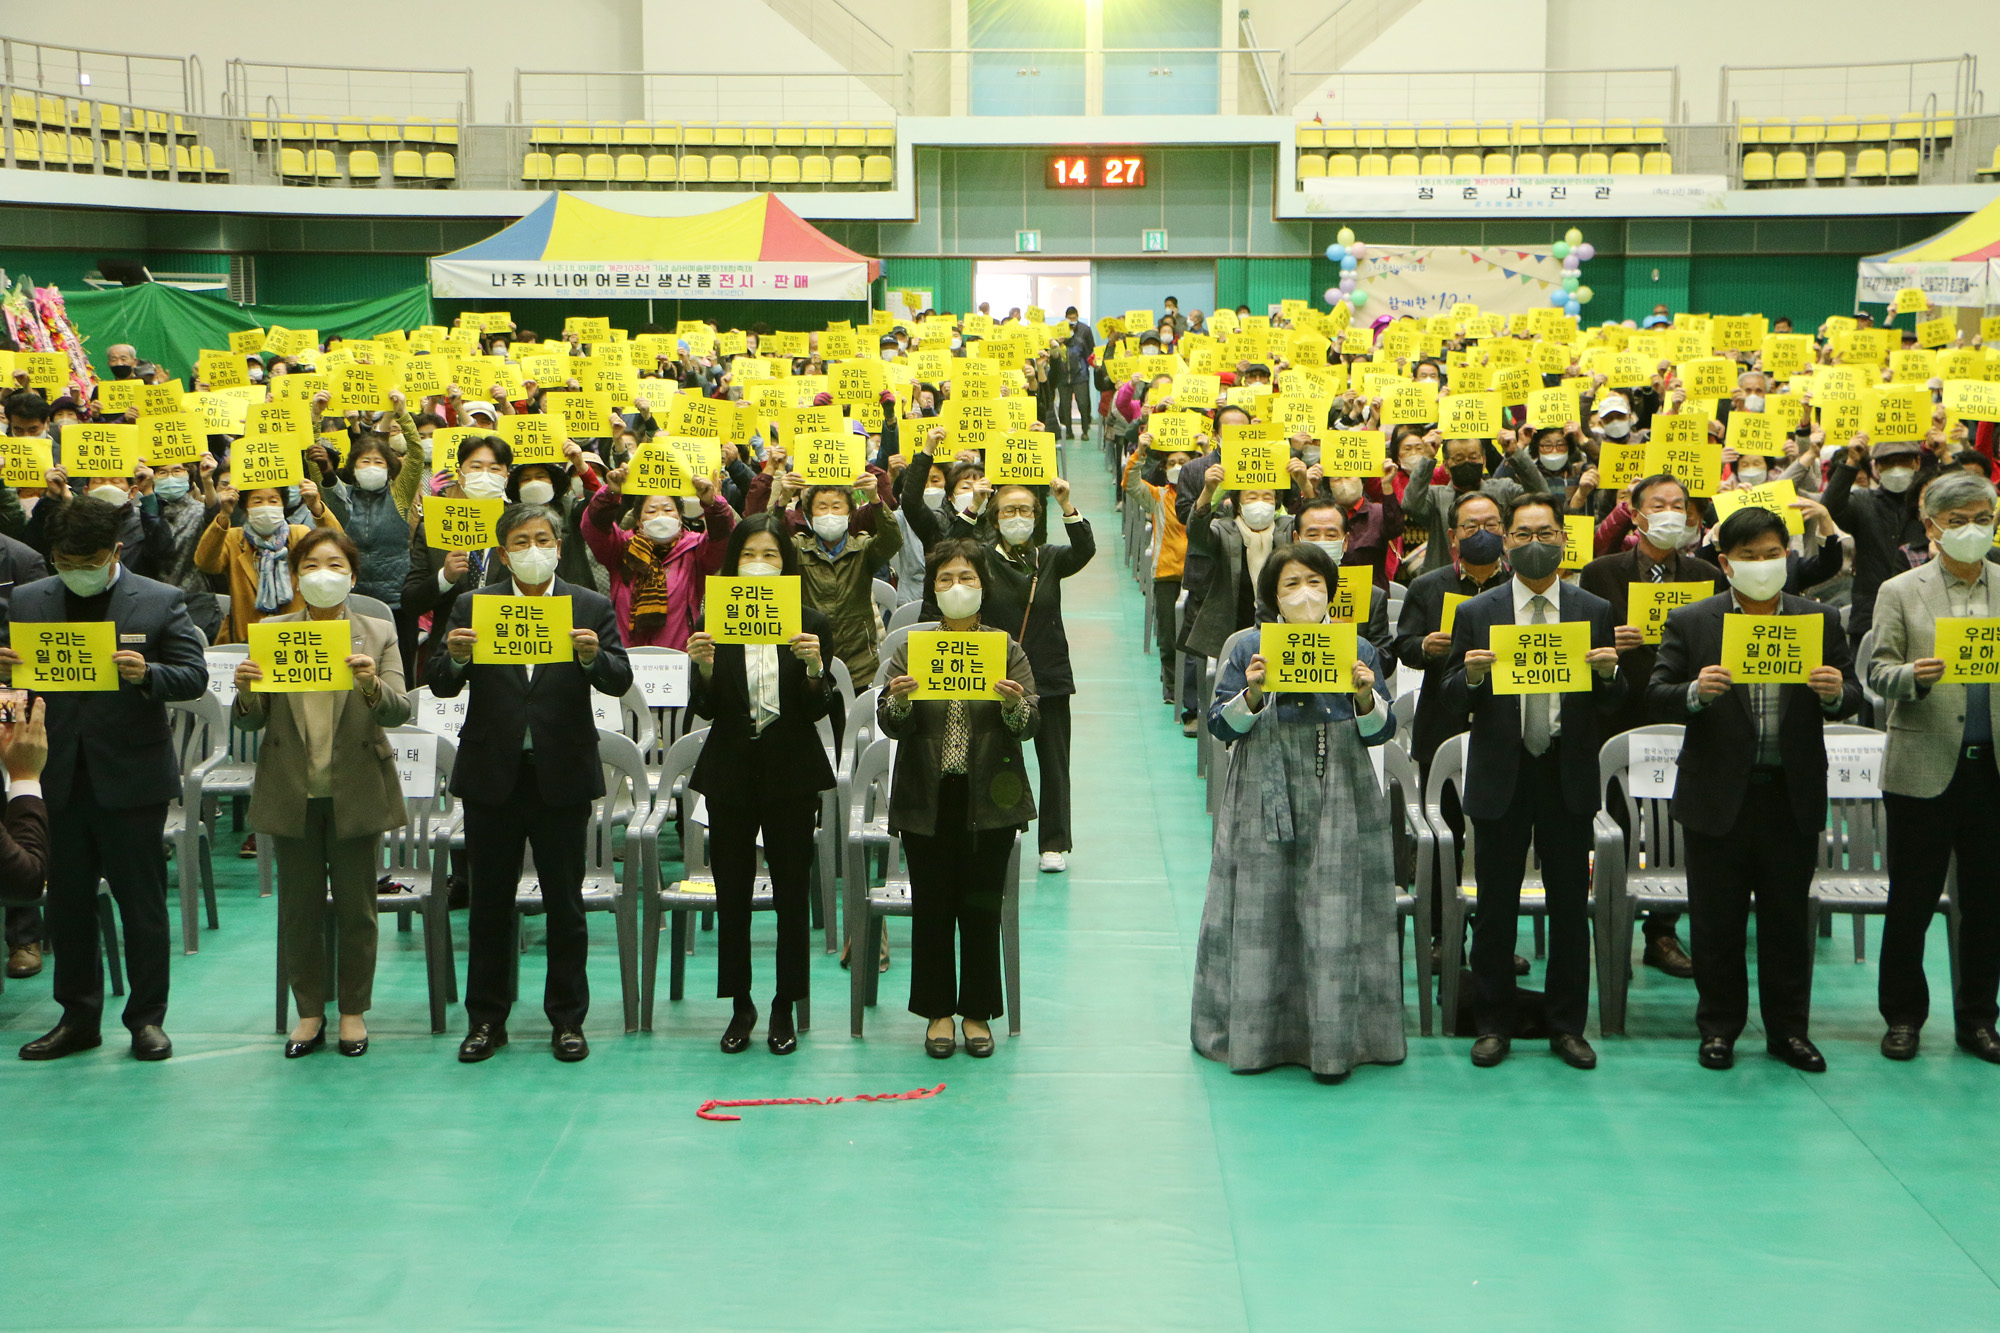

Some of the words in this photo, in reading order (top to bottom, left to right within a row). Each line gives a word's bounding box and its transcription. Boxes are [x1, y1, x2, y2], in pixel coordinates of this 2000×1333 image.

[1054, 160, 1087, 184] 14
[1105, 159, 1141, 183] 27
[657, 274, 711, 288] 생산품
[406, 361, 432, 371] 우리는
[1616, 357, 1637, 365] 우리는
[346, 370, 374, 381] 우리는
[1614, 374, 1644, 383] 노인이다
[404, 381, 440, 393] 노인이다
[1397, 388, 1422, 397] 우리는
[1964, 385, 1992, 394] 우리는
[342, 394, 380, 405] 노인이다
[1542, 392, 1567, 403] 우리는
[688, 402, 716, 415] 우리는
[1288, 403, 1313, 413] 우리는
[1456, 399, 1483, 409] 우리는
[1880, 399, 1912, 410] 우리는
[1956, 404, 1998, 416] 노인이다
[1393, 409, 1427, 419] 노인이다
[1538, 414, 1564, 423] 노인이다
[154, 421, 187, 433] 우리는
[517, 421, 547, 432] 우리는
[1163, 418, 1186, 426] 우리는
[1450, 423, 1489, 433] 노인이다
[1744, 418, 1770, 429] 우리는
[680, 425, 718, 437] 노인이다
[1284, 424, 1316, 434] 노인이다
[1875, 424, 1918, 436] 노인이다
[82, 431, 116, 443] 우리는
[1158, 438, 1190, 447] 노인이다
[1340, 437, 1368, 447] 우리는
[246, 442, 279, 455] 우리는
[813, 440, 845, 451] 우리는
[1006, 439, 1038, 450] 우리는
[1737, 440, 1773, 451] 노인이다
[153, 446, 196, 460] 노인이다
[513, 446, 555, 458] 노인이다
[644, 450, 675, 462] 우리는
[1241, 448, 1271, 458] 우리는
[77, 459, 124, 471] 노인이다
[1334, 461, 1372, 471] 노인이다
[243, 468, 289, 483] 노인이다
[807, 467, 851, 478] 노인이다
[1000, 467, 1044, 478] 노인이다
[1236, 473, 1277, 484] 노인이다
[638, 478, 682, 490] 노인이다
[445, 506, 481, 519] 우리는
[441, 533, 488, 547] 노인이다
[731, 586, 774, 601] 우리는
[1654, 592, 1692, 605] 우리는
[500, 605, 544, 620] 우리는
[724, 622, 782, 636] 노인이다
[1752, 625, 1797, 640] 우리는
[1965, 627, 2000, 642] 우리
[40, 632, 86, 646] 우리는
[278, 632, 322, 647] 우리는
[1287, 634, 1331, 648] 우리는
[1518, 633, 1562, 649] 우리는
[494, 641, 553, 656] 노인이다
[936, 641, 979, 656] 우리는
[1742, 661, 1803, 675] 노인이다
[1954, 662, 1999, 676] 노인이
[35, 667, 97, 682] 노인이다
[273, 667, 333, 683] 노인이다
[1280, 669, 1338, 684] 노인이다
[1512, 668, 1571, 685] 노인이다
[928, 677, 987, 692] 노인이다
